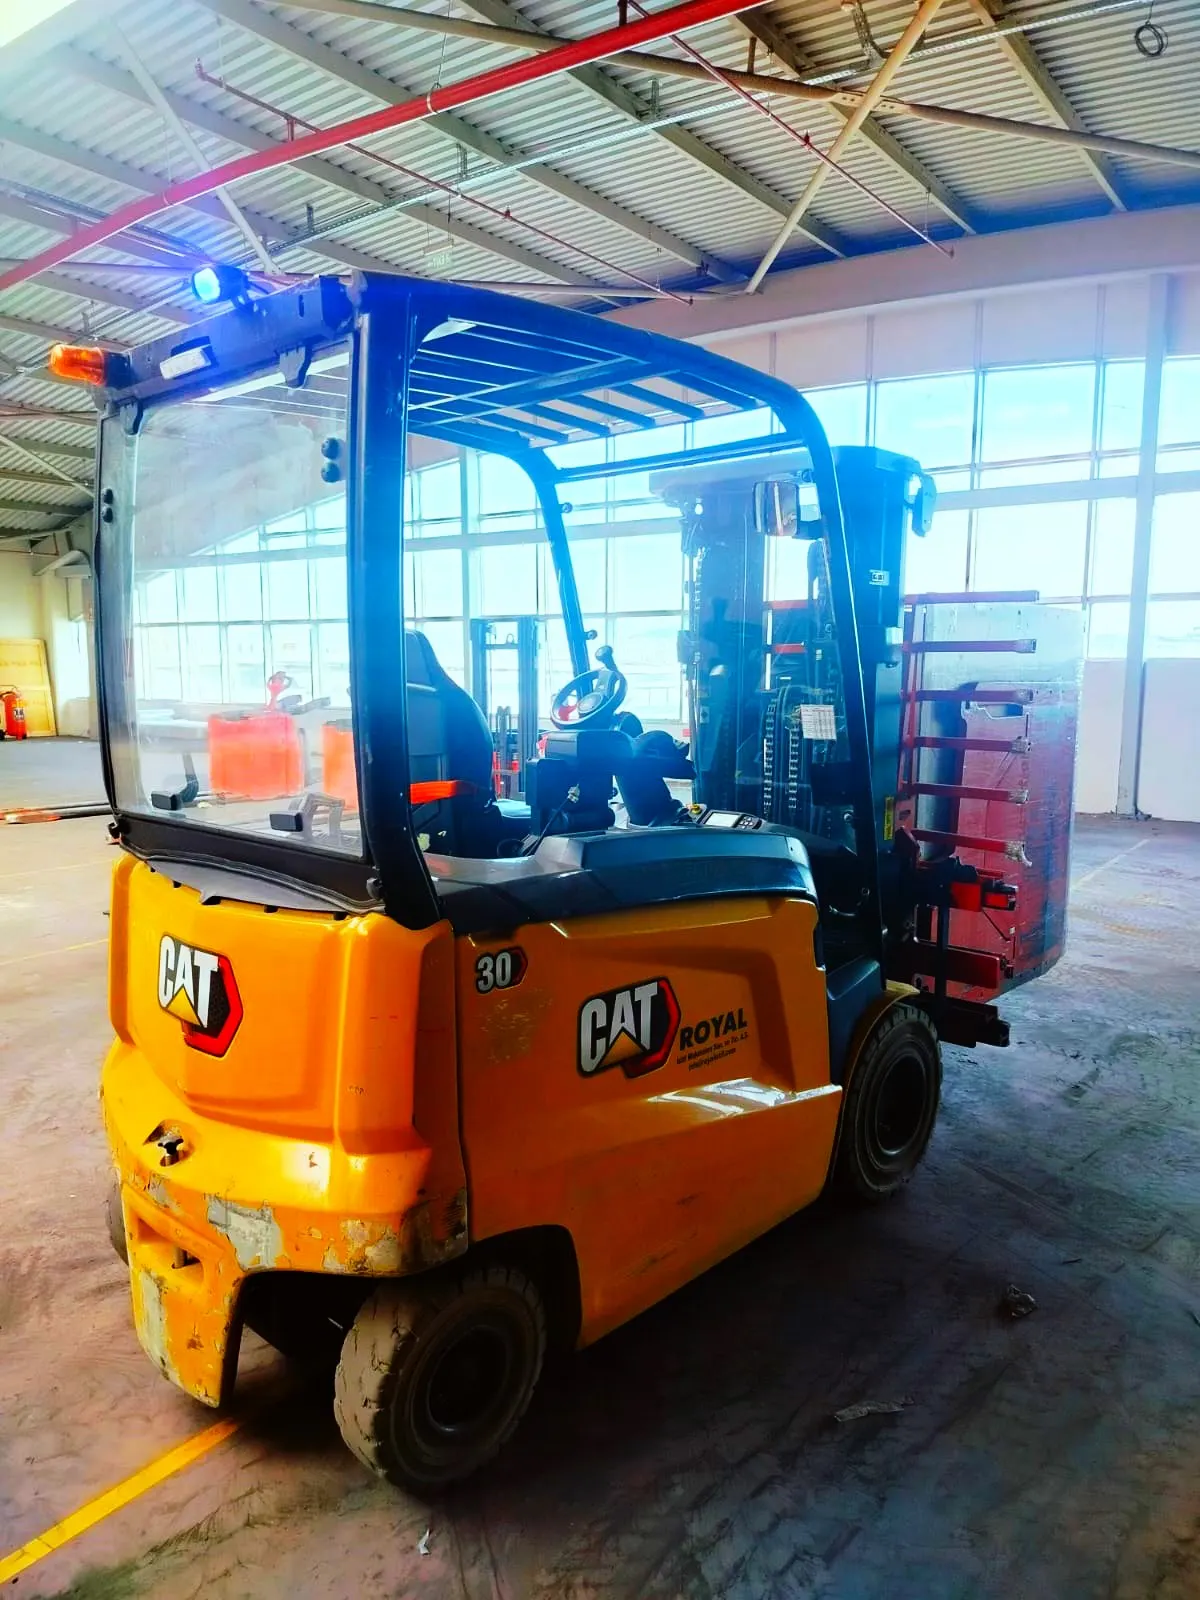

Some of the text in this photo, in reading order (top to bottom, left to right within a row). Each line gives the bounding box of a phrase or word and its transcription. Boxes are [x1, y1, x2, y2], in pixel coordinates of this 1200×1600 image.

[159, 935, 219, 1028] CAT
[477, 951, 512, 991] 30
[581, 981, 658, 1073] CAT
[680, 1008, 748, 1051] ROYAL
